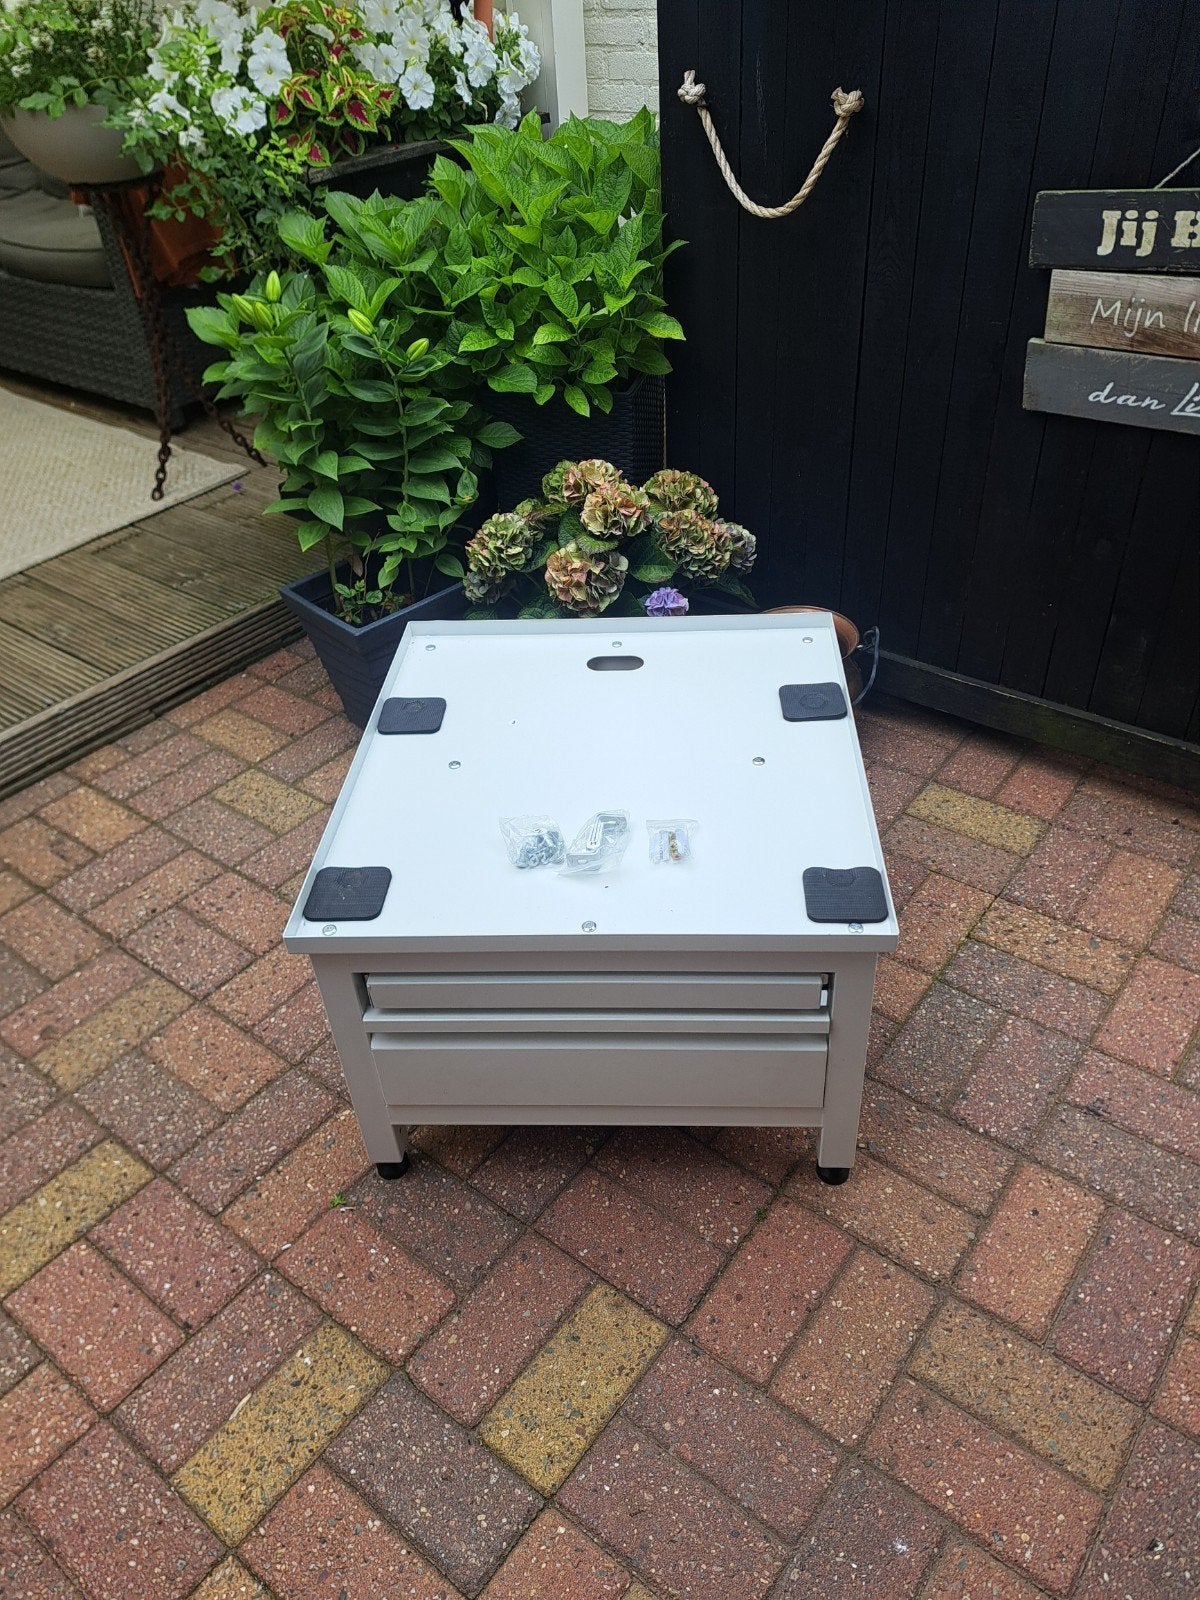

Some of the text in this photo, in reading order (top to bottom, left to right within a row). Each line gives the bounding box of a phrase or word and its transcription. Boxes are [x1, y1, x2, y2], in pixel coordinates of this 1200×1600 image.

[1097, 209, 1159, 256] Jij
[1090, 297, 1165, 338] Mijn
[1088, 382, 1166, 410] dan
